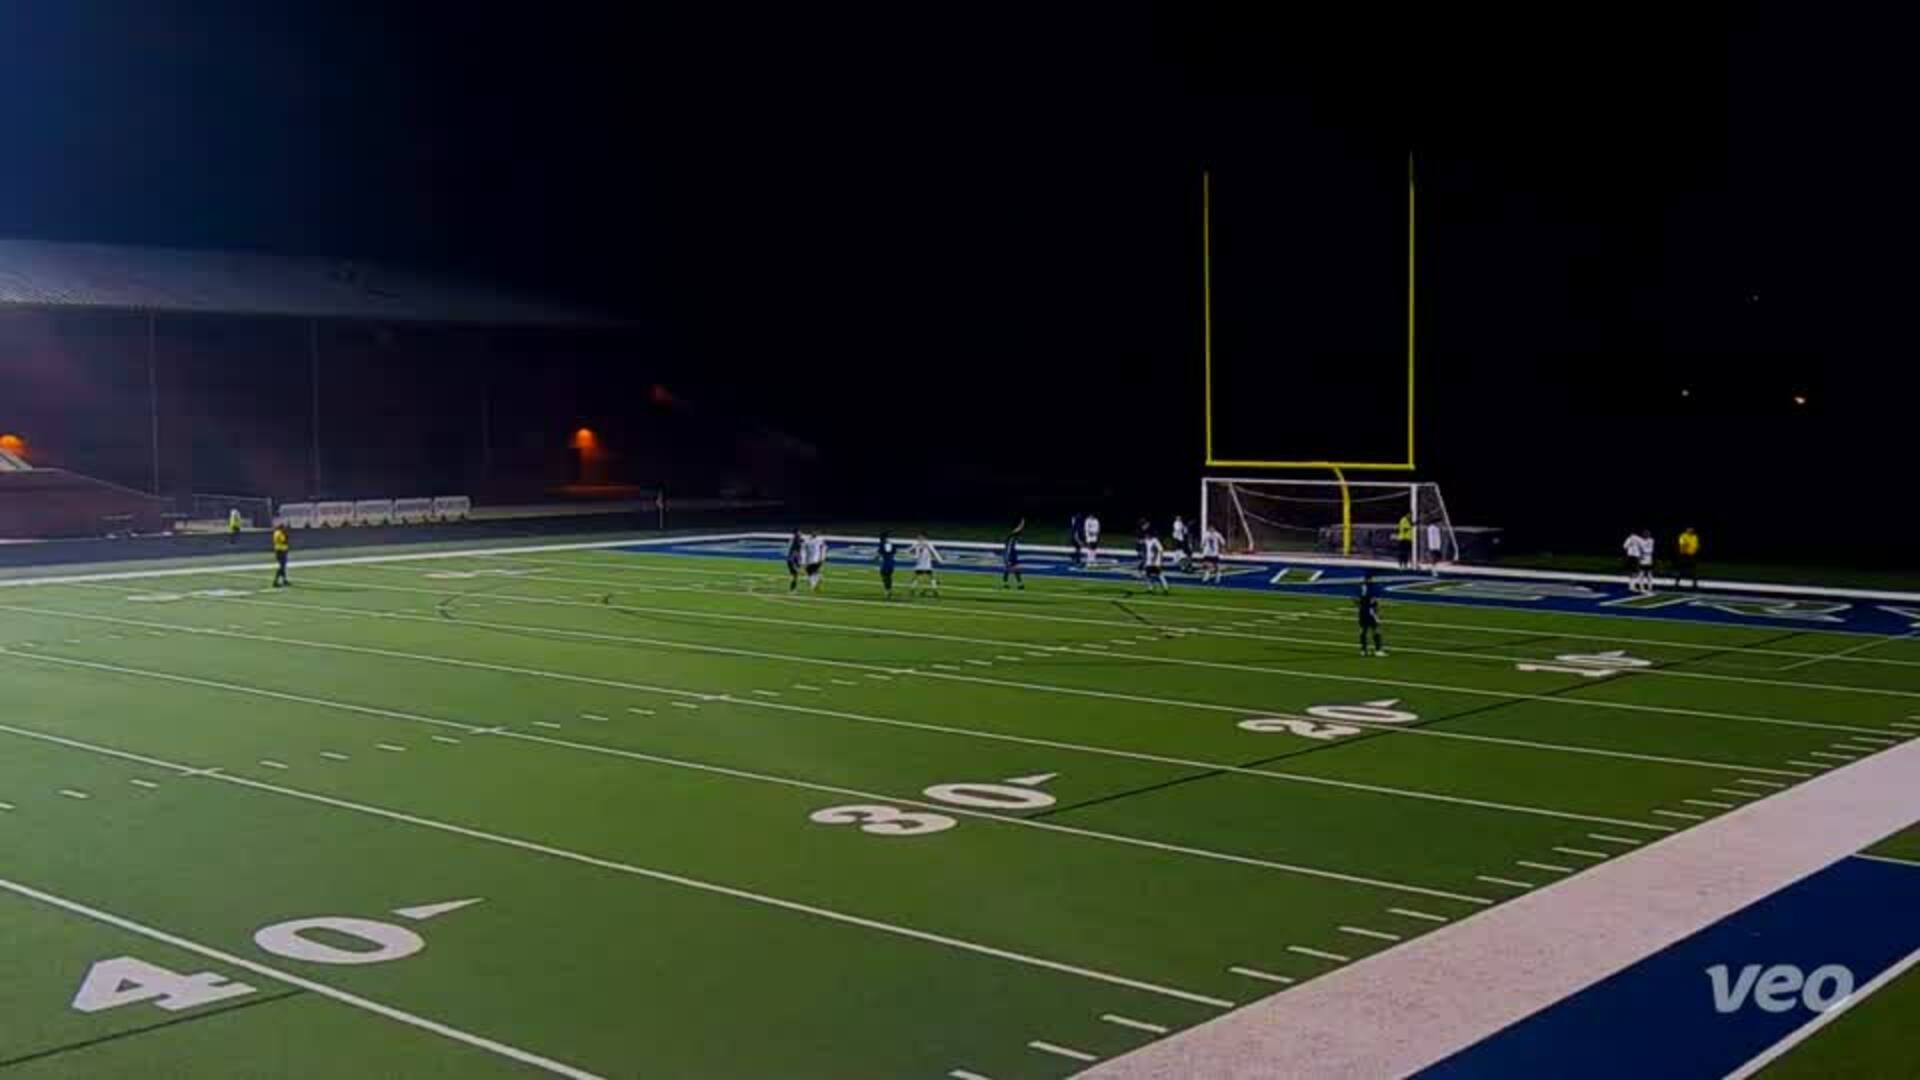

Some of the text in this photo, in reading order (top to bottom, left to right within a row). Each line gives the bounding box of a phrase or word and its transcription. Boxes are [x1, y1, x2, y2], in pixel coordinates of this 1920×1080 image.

[1515, 653, 1653, 677] 10
[1237, 704, 1419, 740] 20
[809, 783, 1056, 835] 30
[71, 916, 426, 1013] 40
